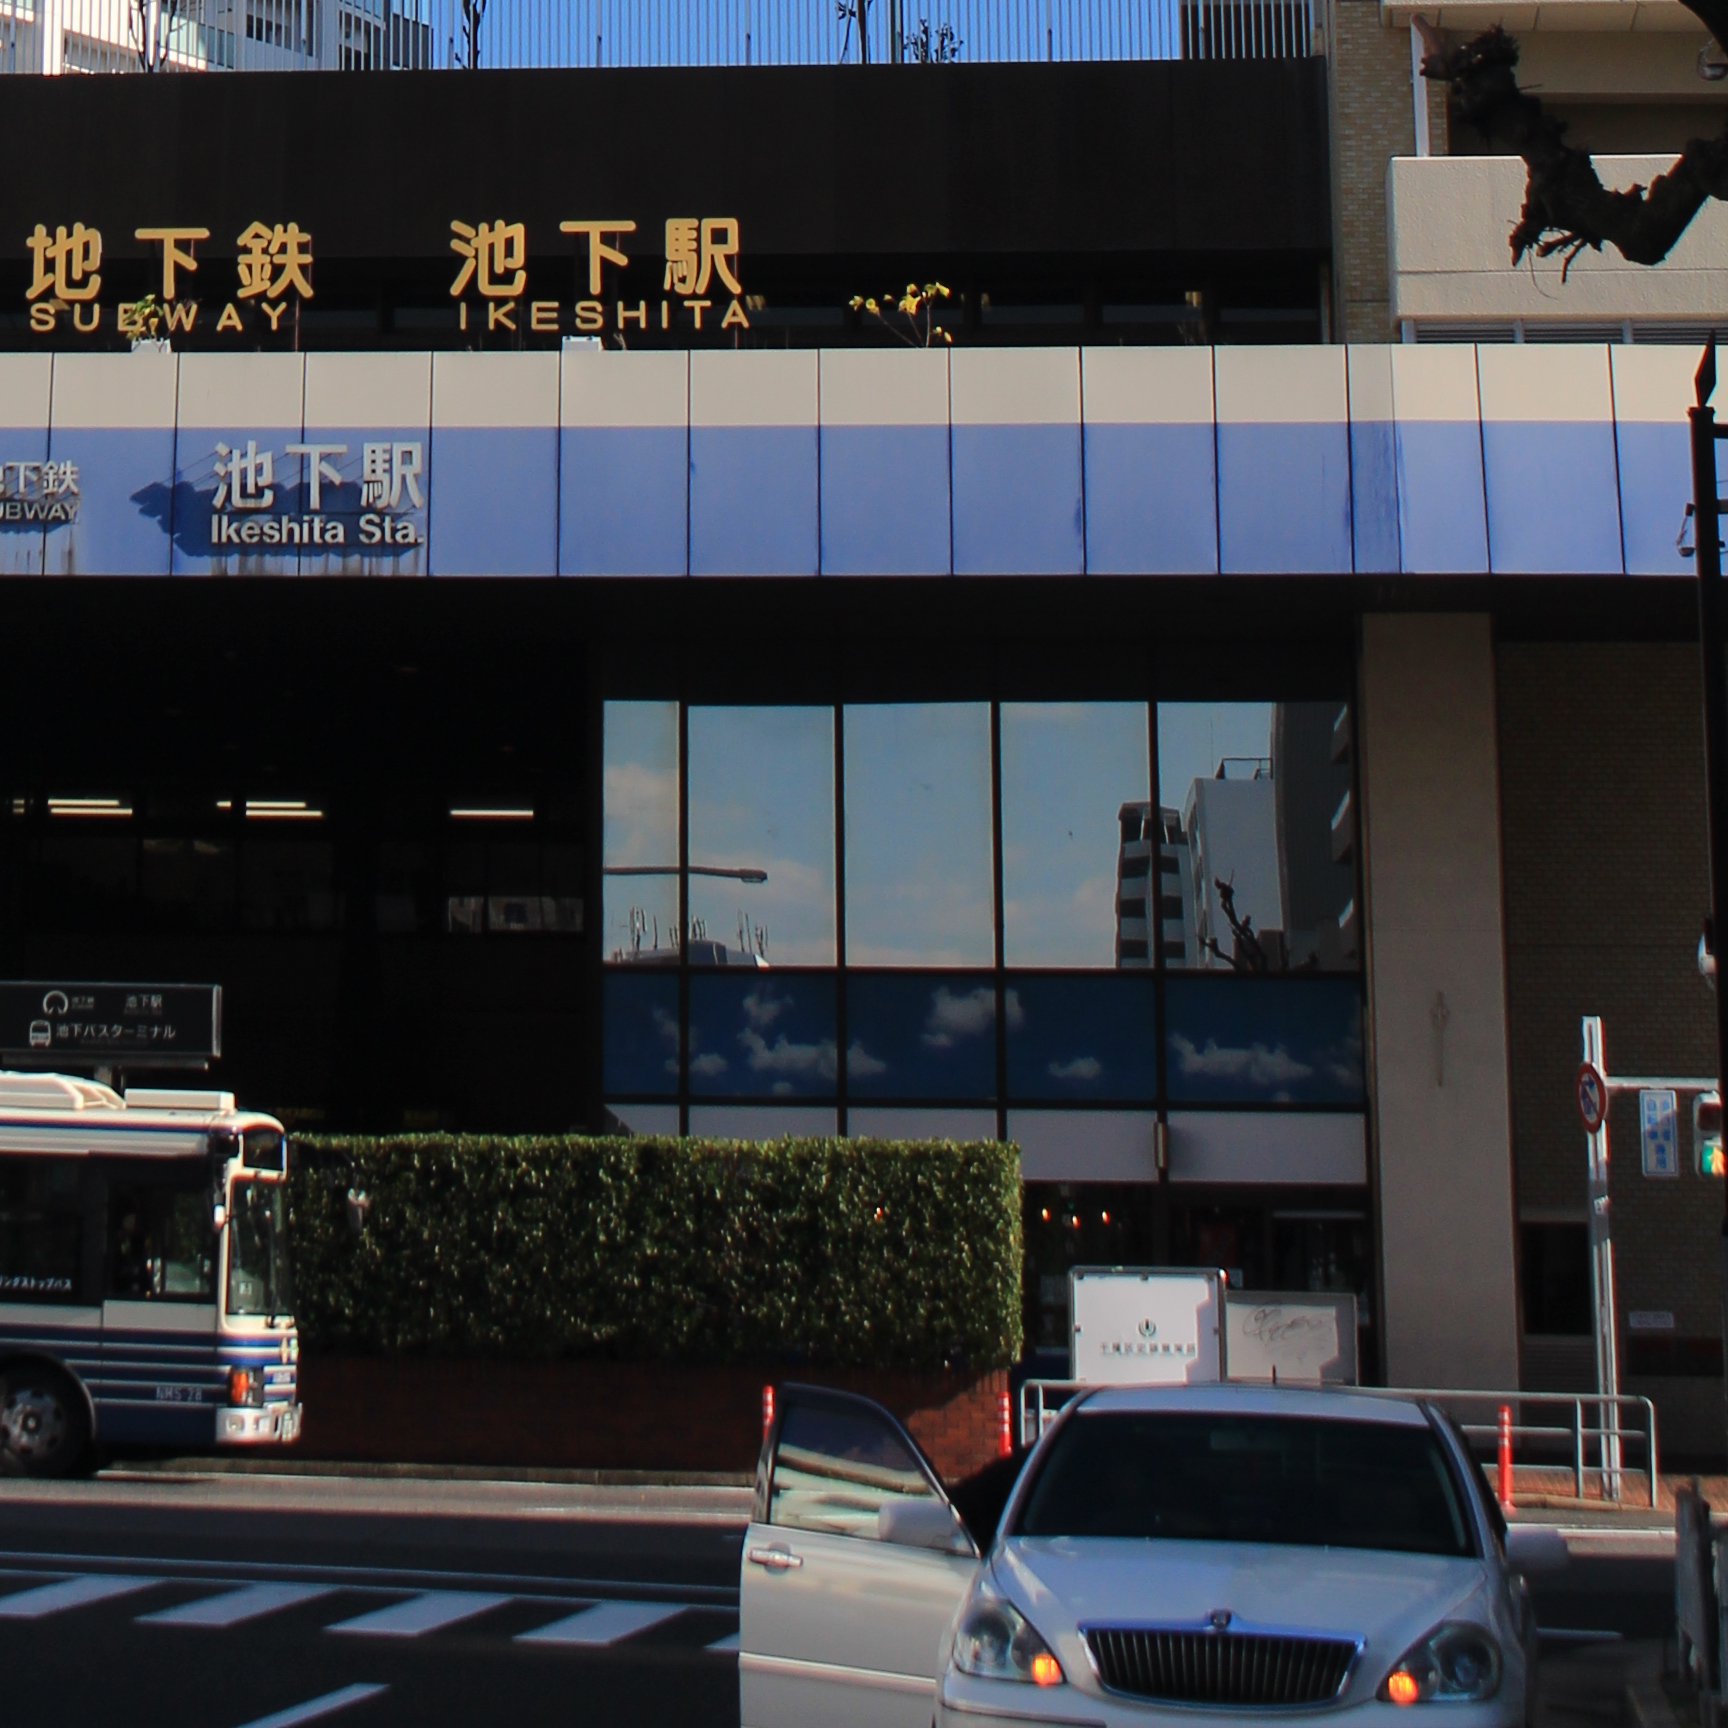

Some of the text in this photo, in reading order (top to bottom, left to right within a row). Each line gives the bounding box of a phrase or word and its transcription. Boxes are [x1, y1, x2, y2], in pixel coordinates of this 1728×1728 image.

[25, 220, 314, 301] 地下鉄
[449, 216, 742, 297] 池下駅
[30, 301, 290, 333] SUBWAY
[459, 298, 751, 331] IKESHITA
[212, 440, 424, 511] 池下駅
[210, 513, 425, 545] Ikeshita Sta.
[55, 1022, 177, 1040] 池下バスターミナル
